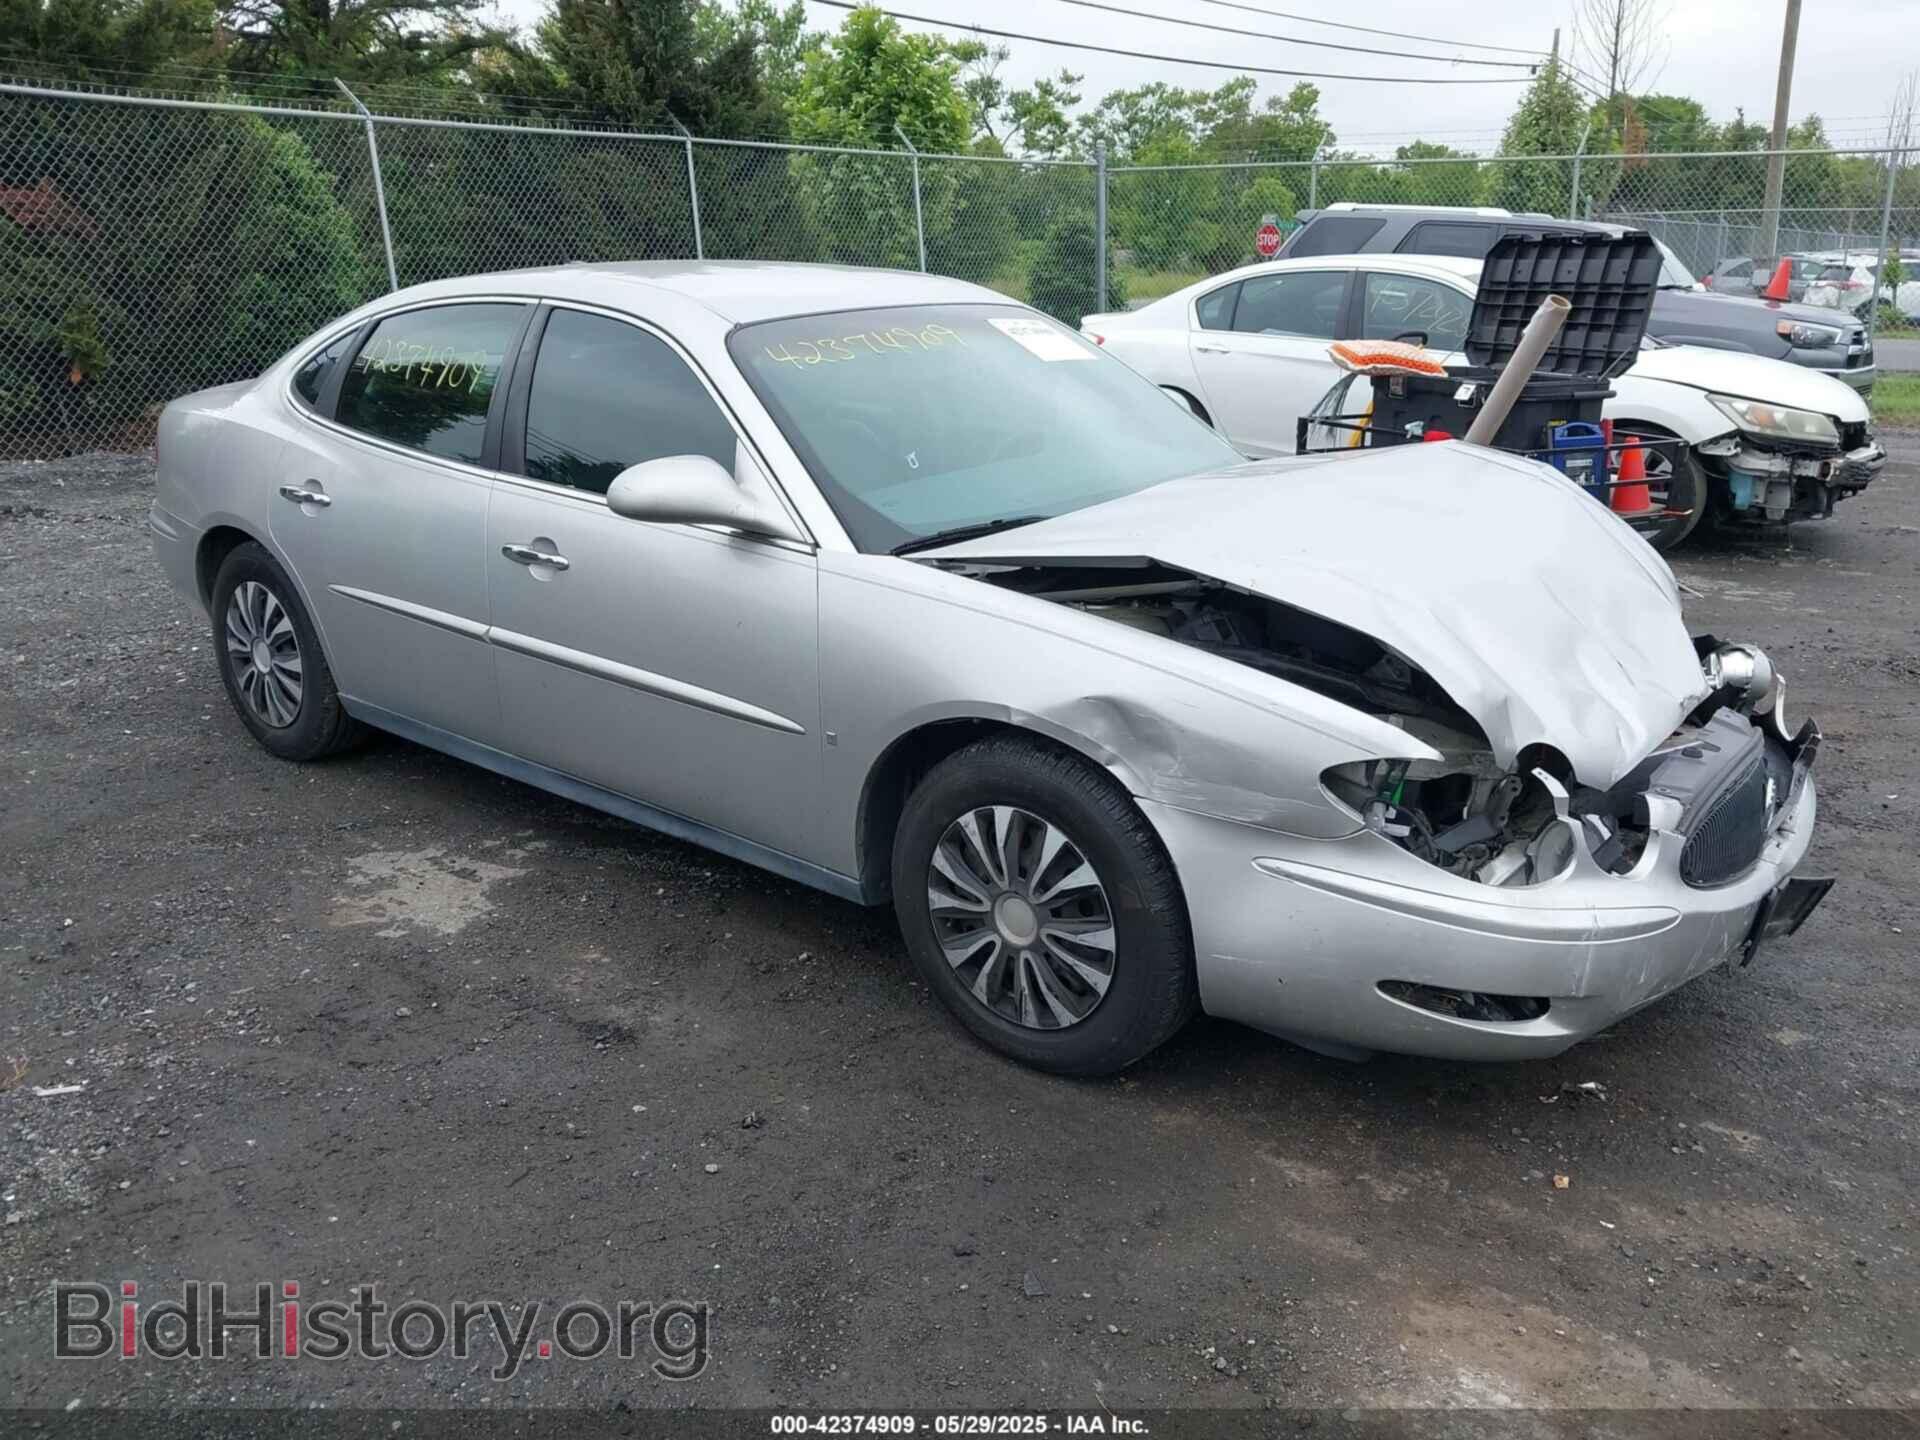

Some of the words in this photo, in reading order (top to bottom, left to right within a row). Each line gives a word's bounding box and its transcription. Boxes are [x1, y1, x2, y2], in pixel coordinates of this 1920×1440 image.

[1259, 234, 1279, 245] STOP
[362, 338, 488, 394] 42374909
[763, 323, 968, 371] 42374909
